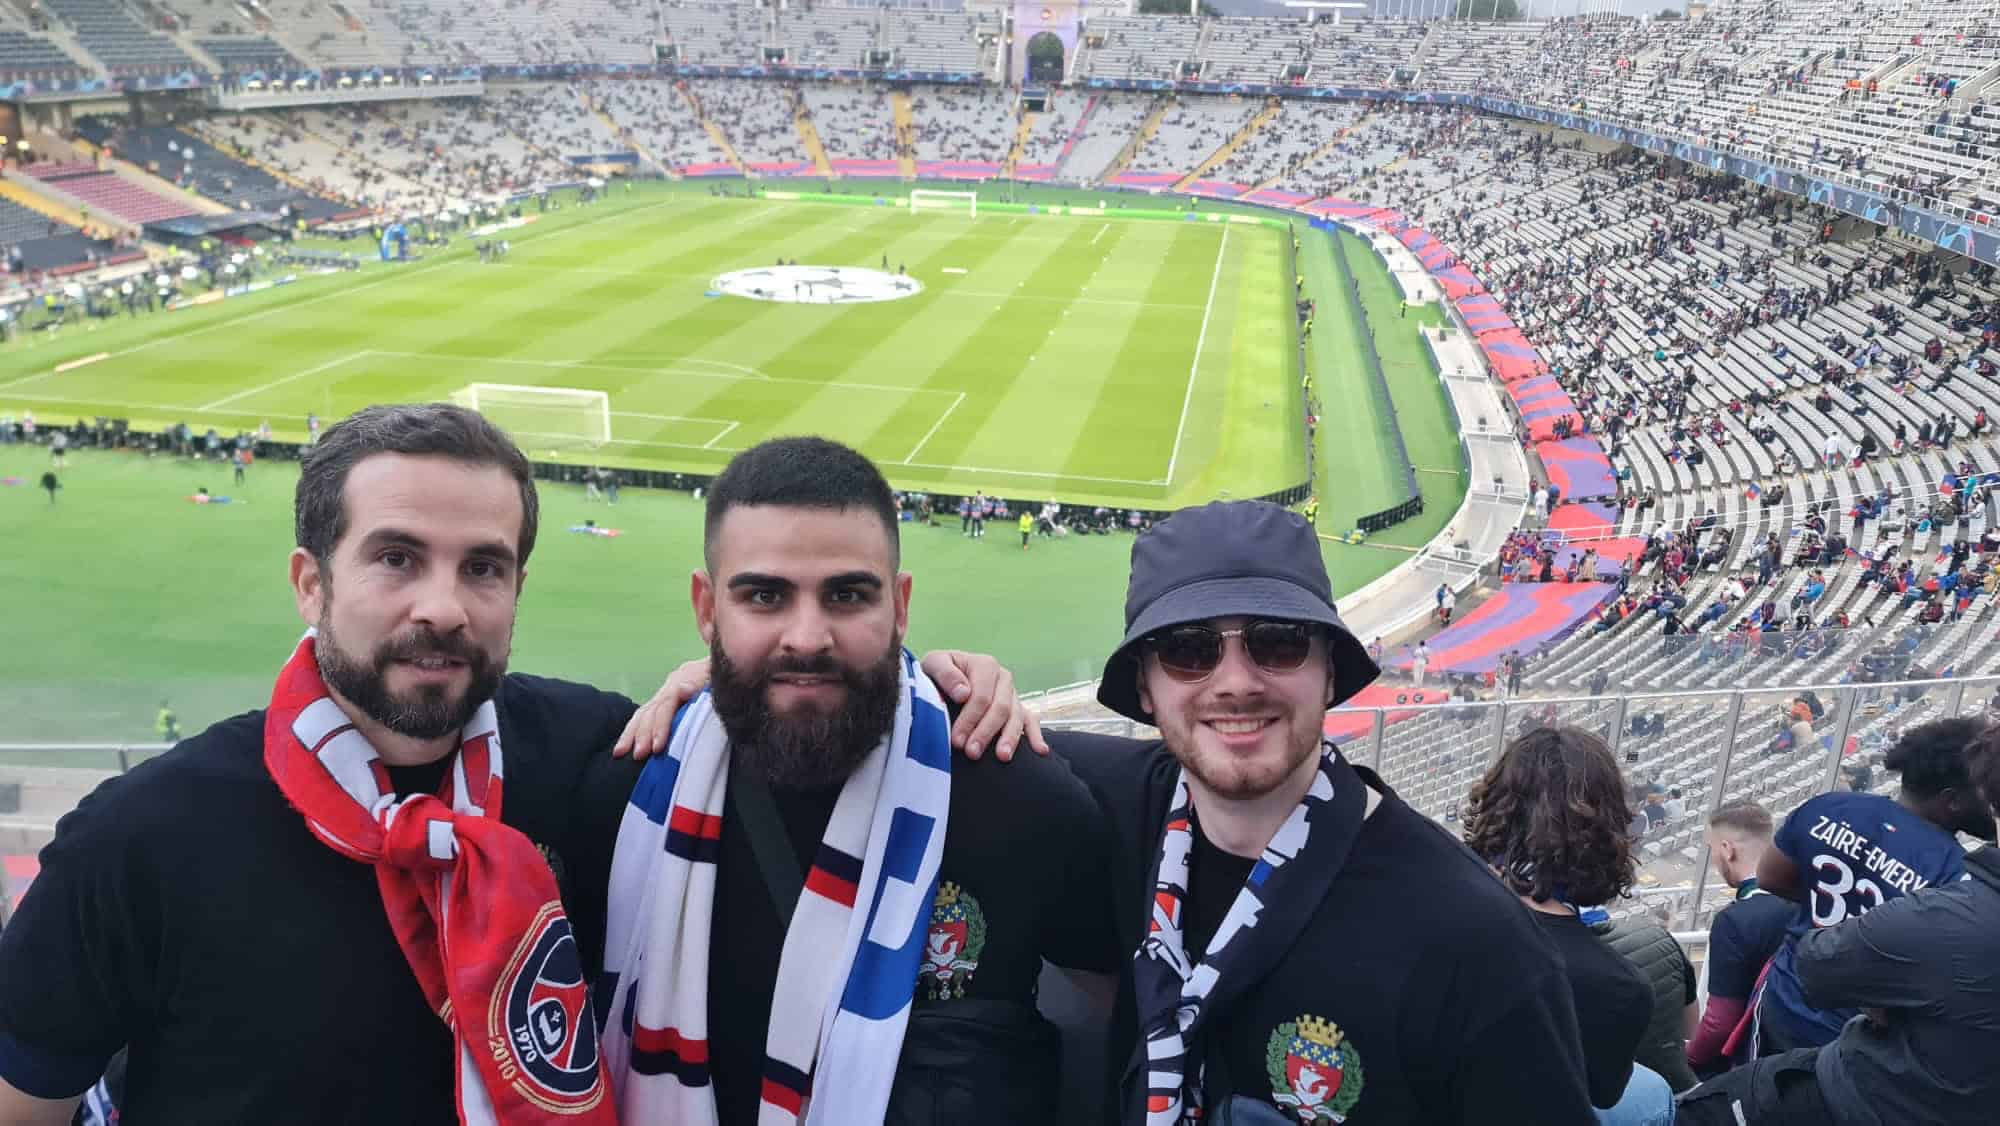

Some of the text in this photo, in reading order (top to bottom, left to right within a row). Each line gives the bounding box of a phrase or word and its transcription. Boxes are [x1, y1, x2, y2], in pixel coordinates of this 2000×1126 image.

[1809, 815, 1929, 893] ZAÏRE-EMERY
[488, 1034, 519, 1081] 2010
[514, 1025, 537, 1063] 1970
